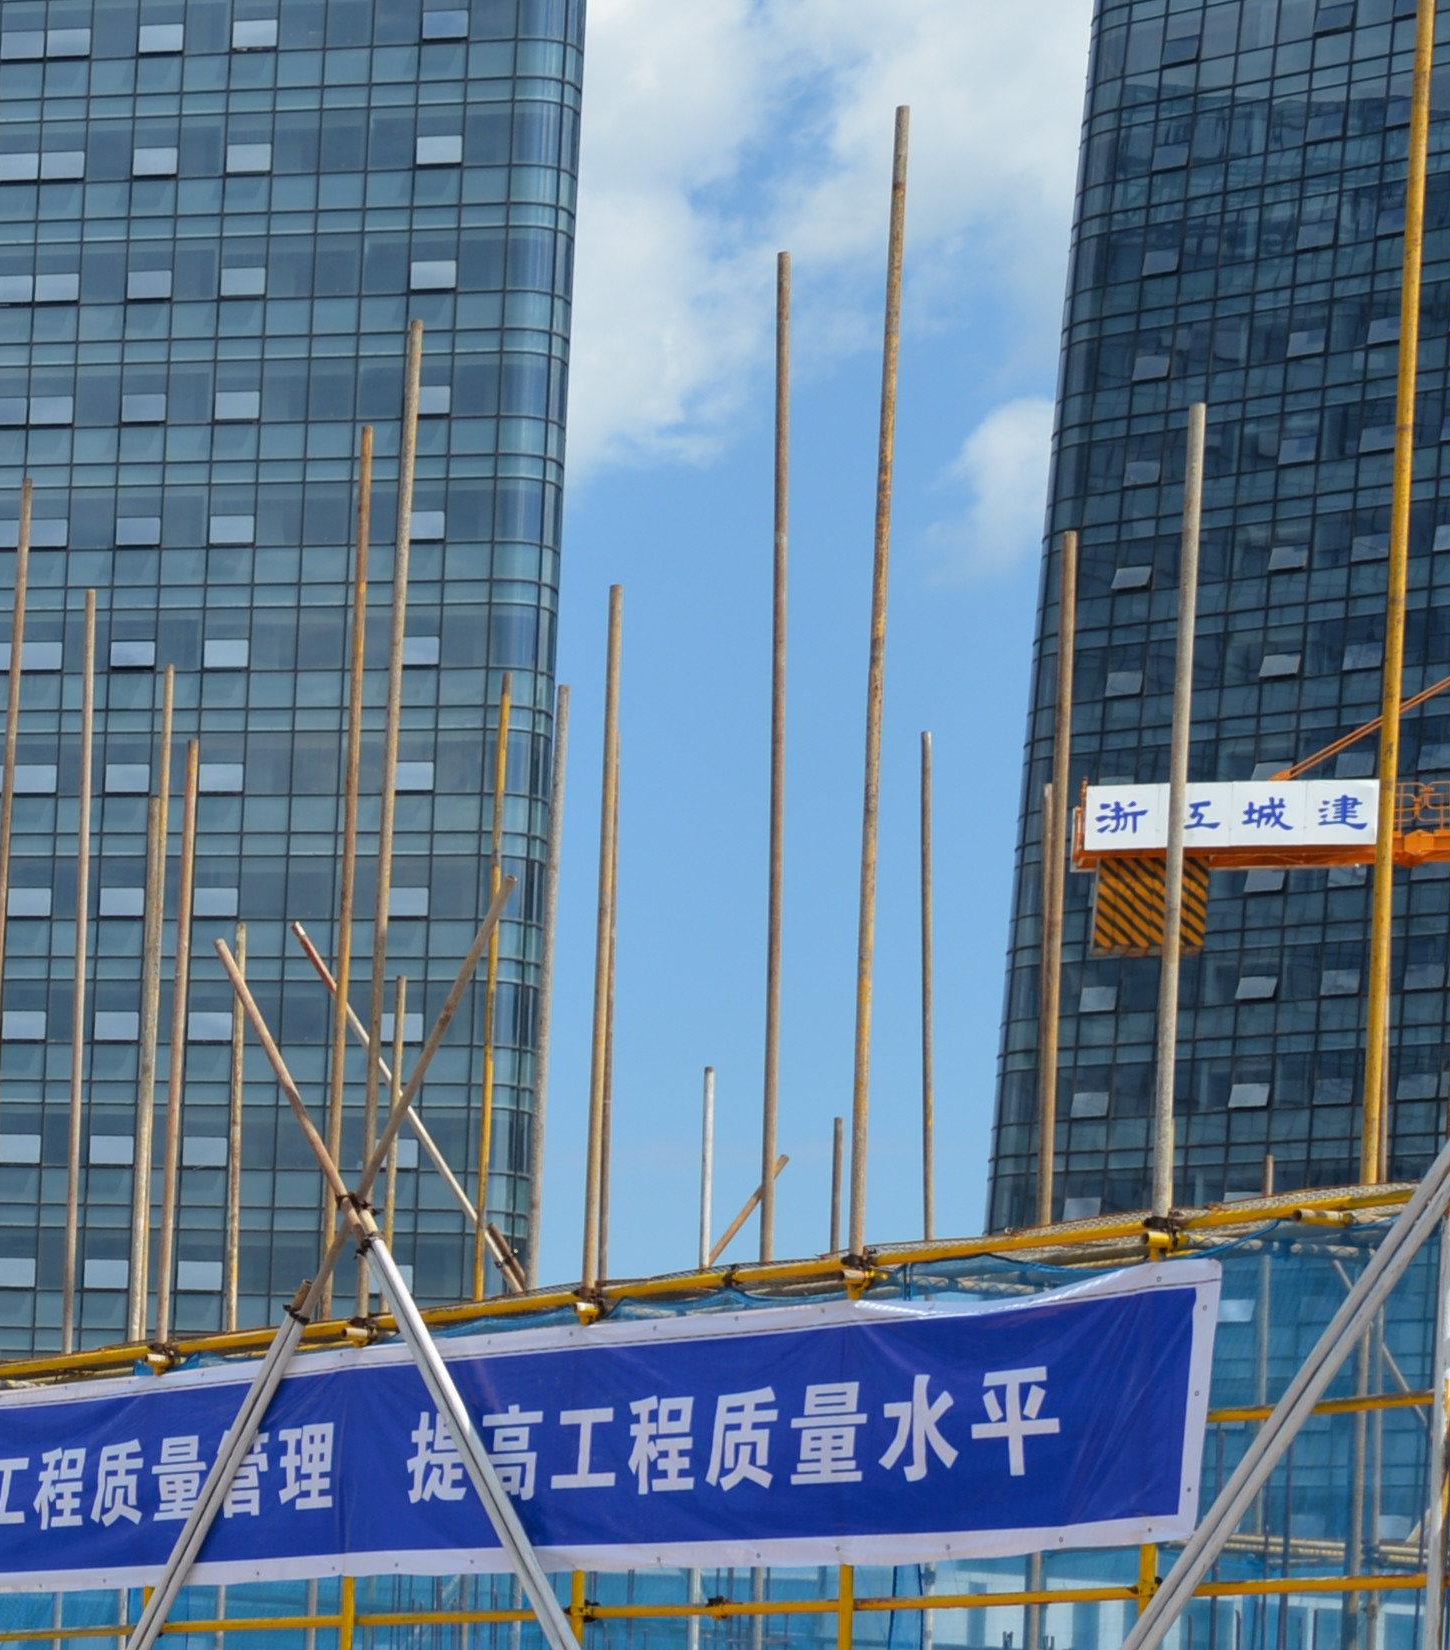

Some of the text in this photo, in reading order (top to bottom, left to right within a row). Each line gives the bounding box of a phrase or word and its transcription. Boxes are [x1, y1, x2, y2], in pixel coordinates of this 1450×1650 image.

[406, 1366, 1061, 1506] 提高工程质量水平
